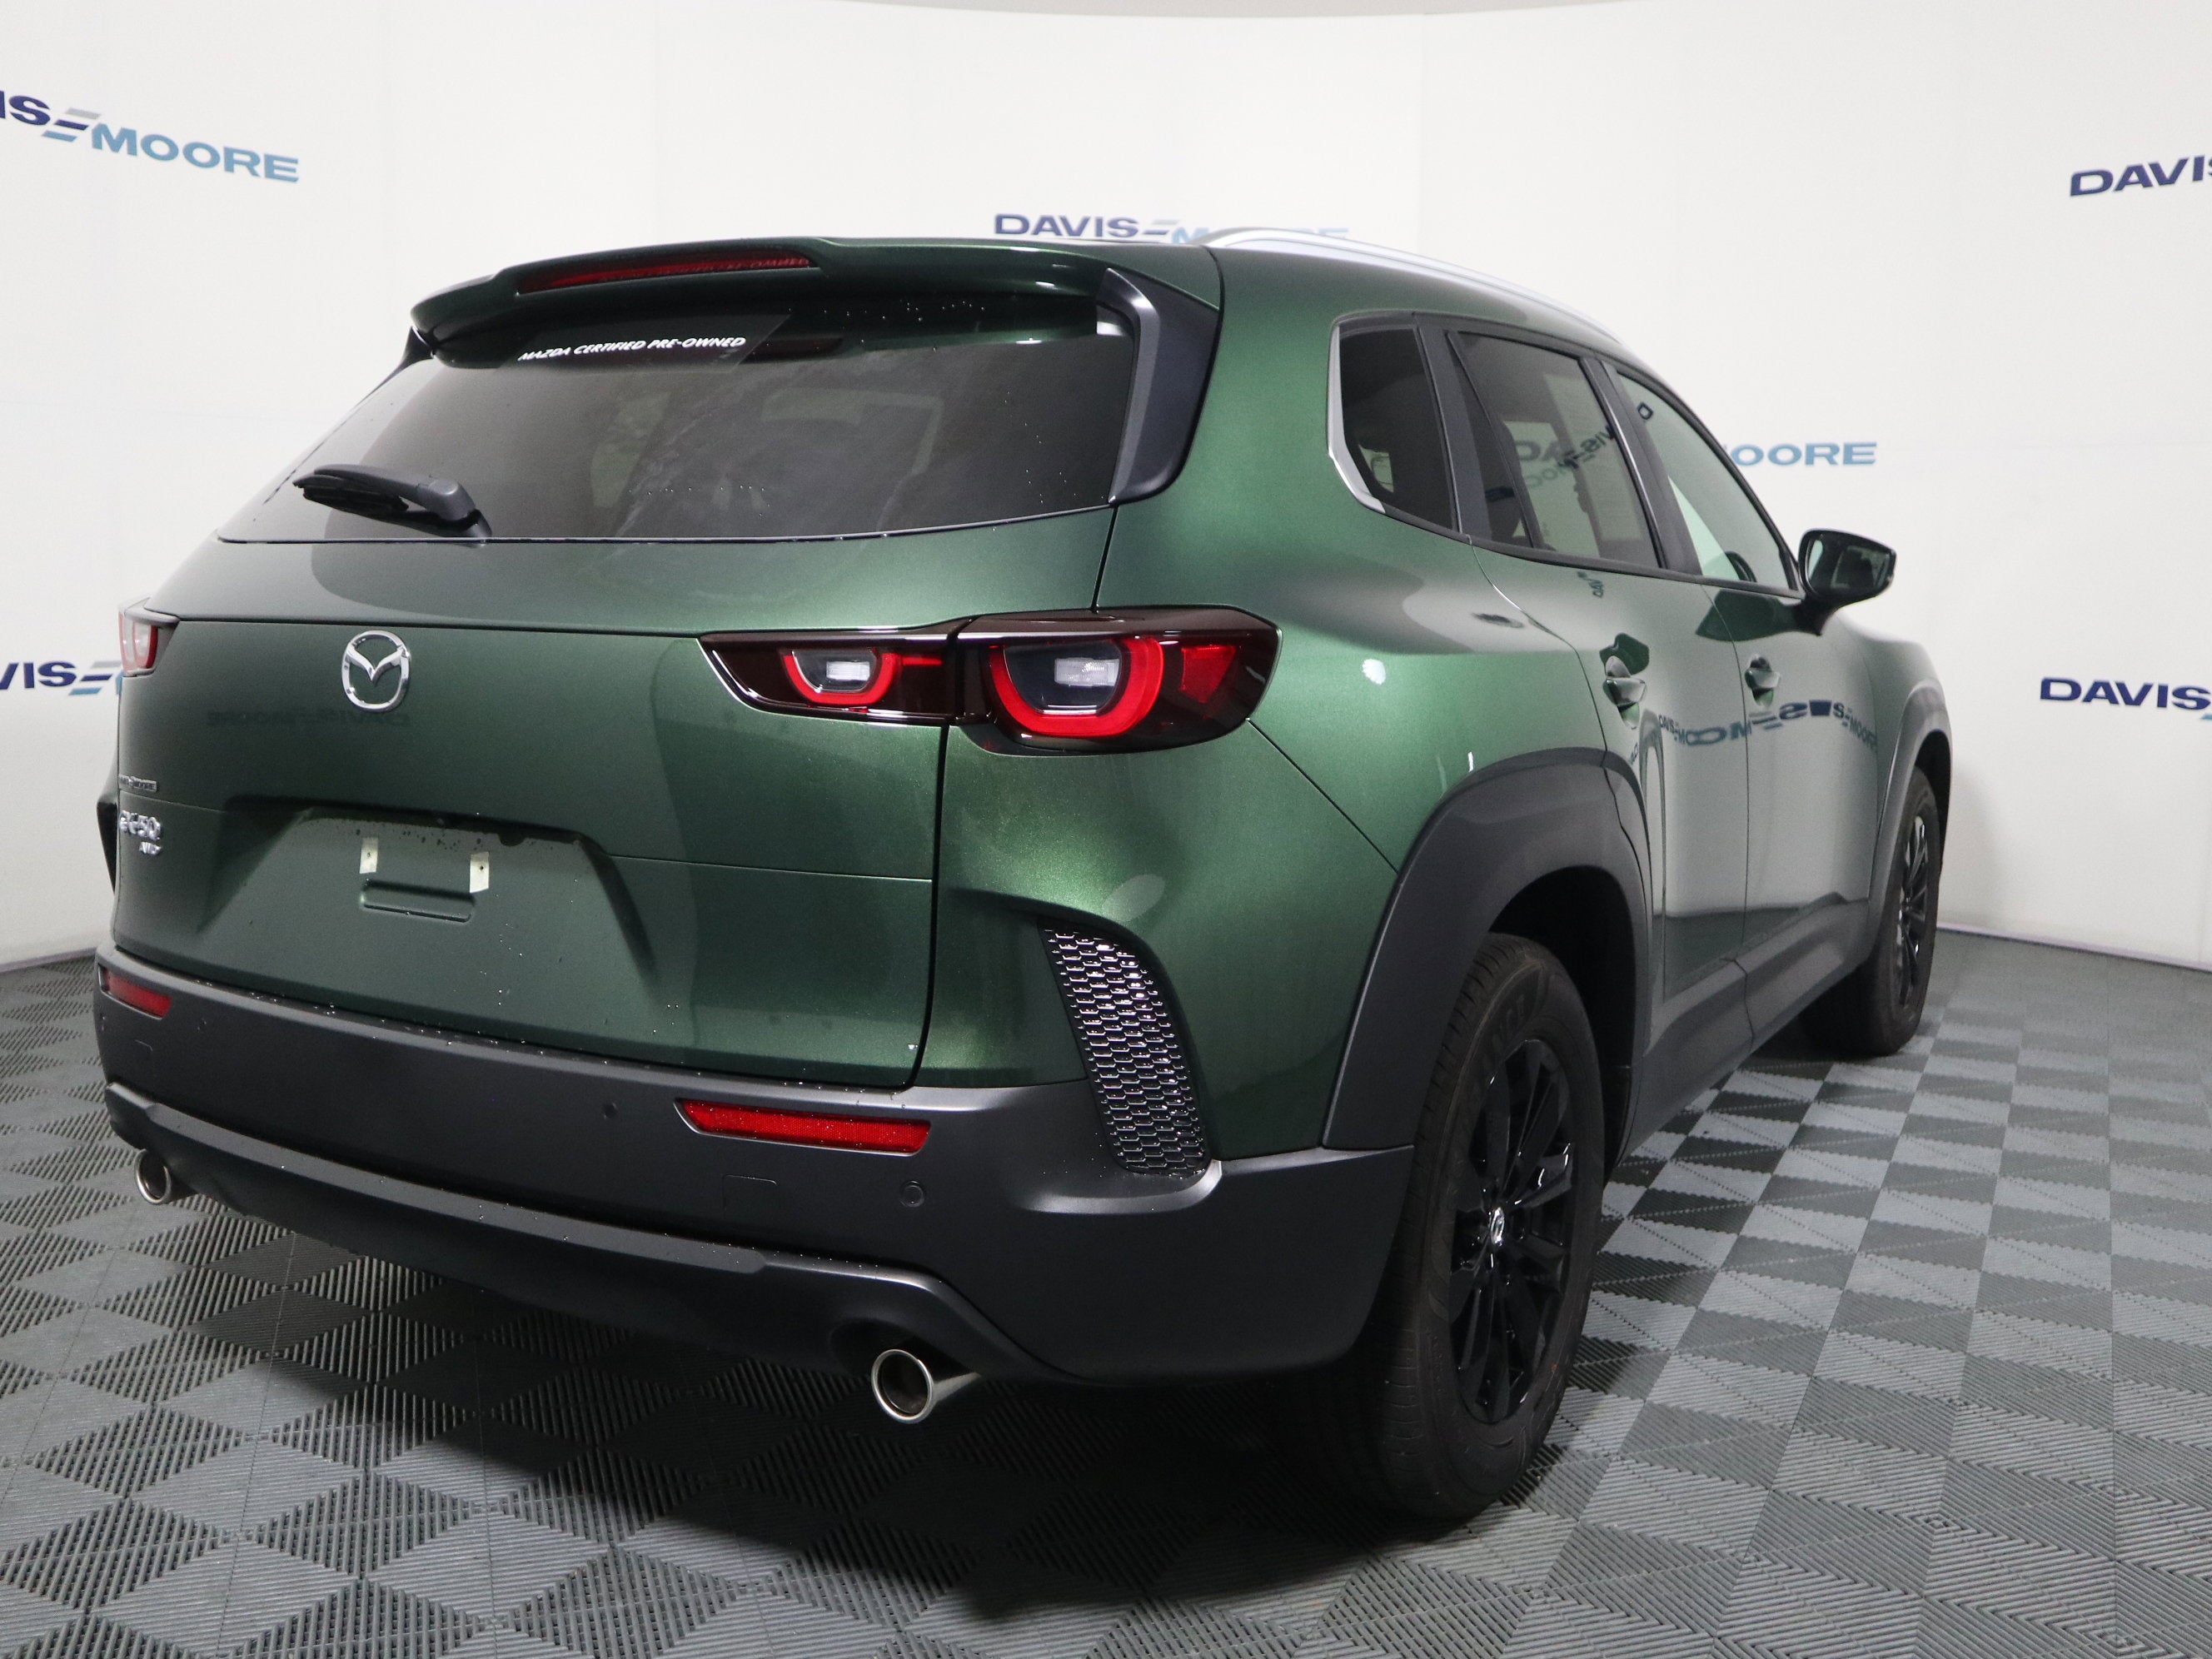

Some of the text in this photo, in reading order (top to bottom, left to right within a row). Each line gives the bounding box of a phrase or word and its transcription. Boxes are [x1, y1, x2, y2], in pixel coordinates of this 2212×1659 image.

[92, 122, 299, 182] MOORE
[2070, 153, 2212, 197] DAVI
[994, 213, 1138, 237] DAVIS
[573, 340, 647, 355] CERTIFIED
[647, 336, 746, 349] PRE-OWNED
[1724, 441, 1877, 466] OORE
[2040, 676, 2211, 710] DAVIS
